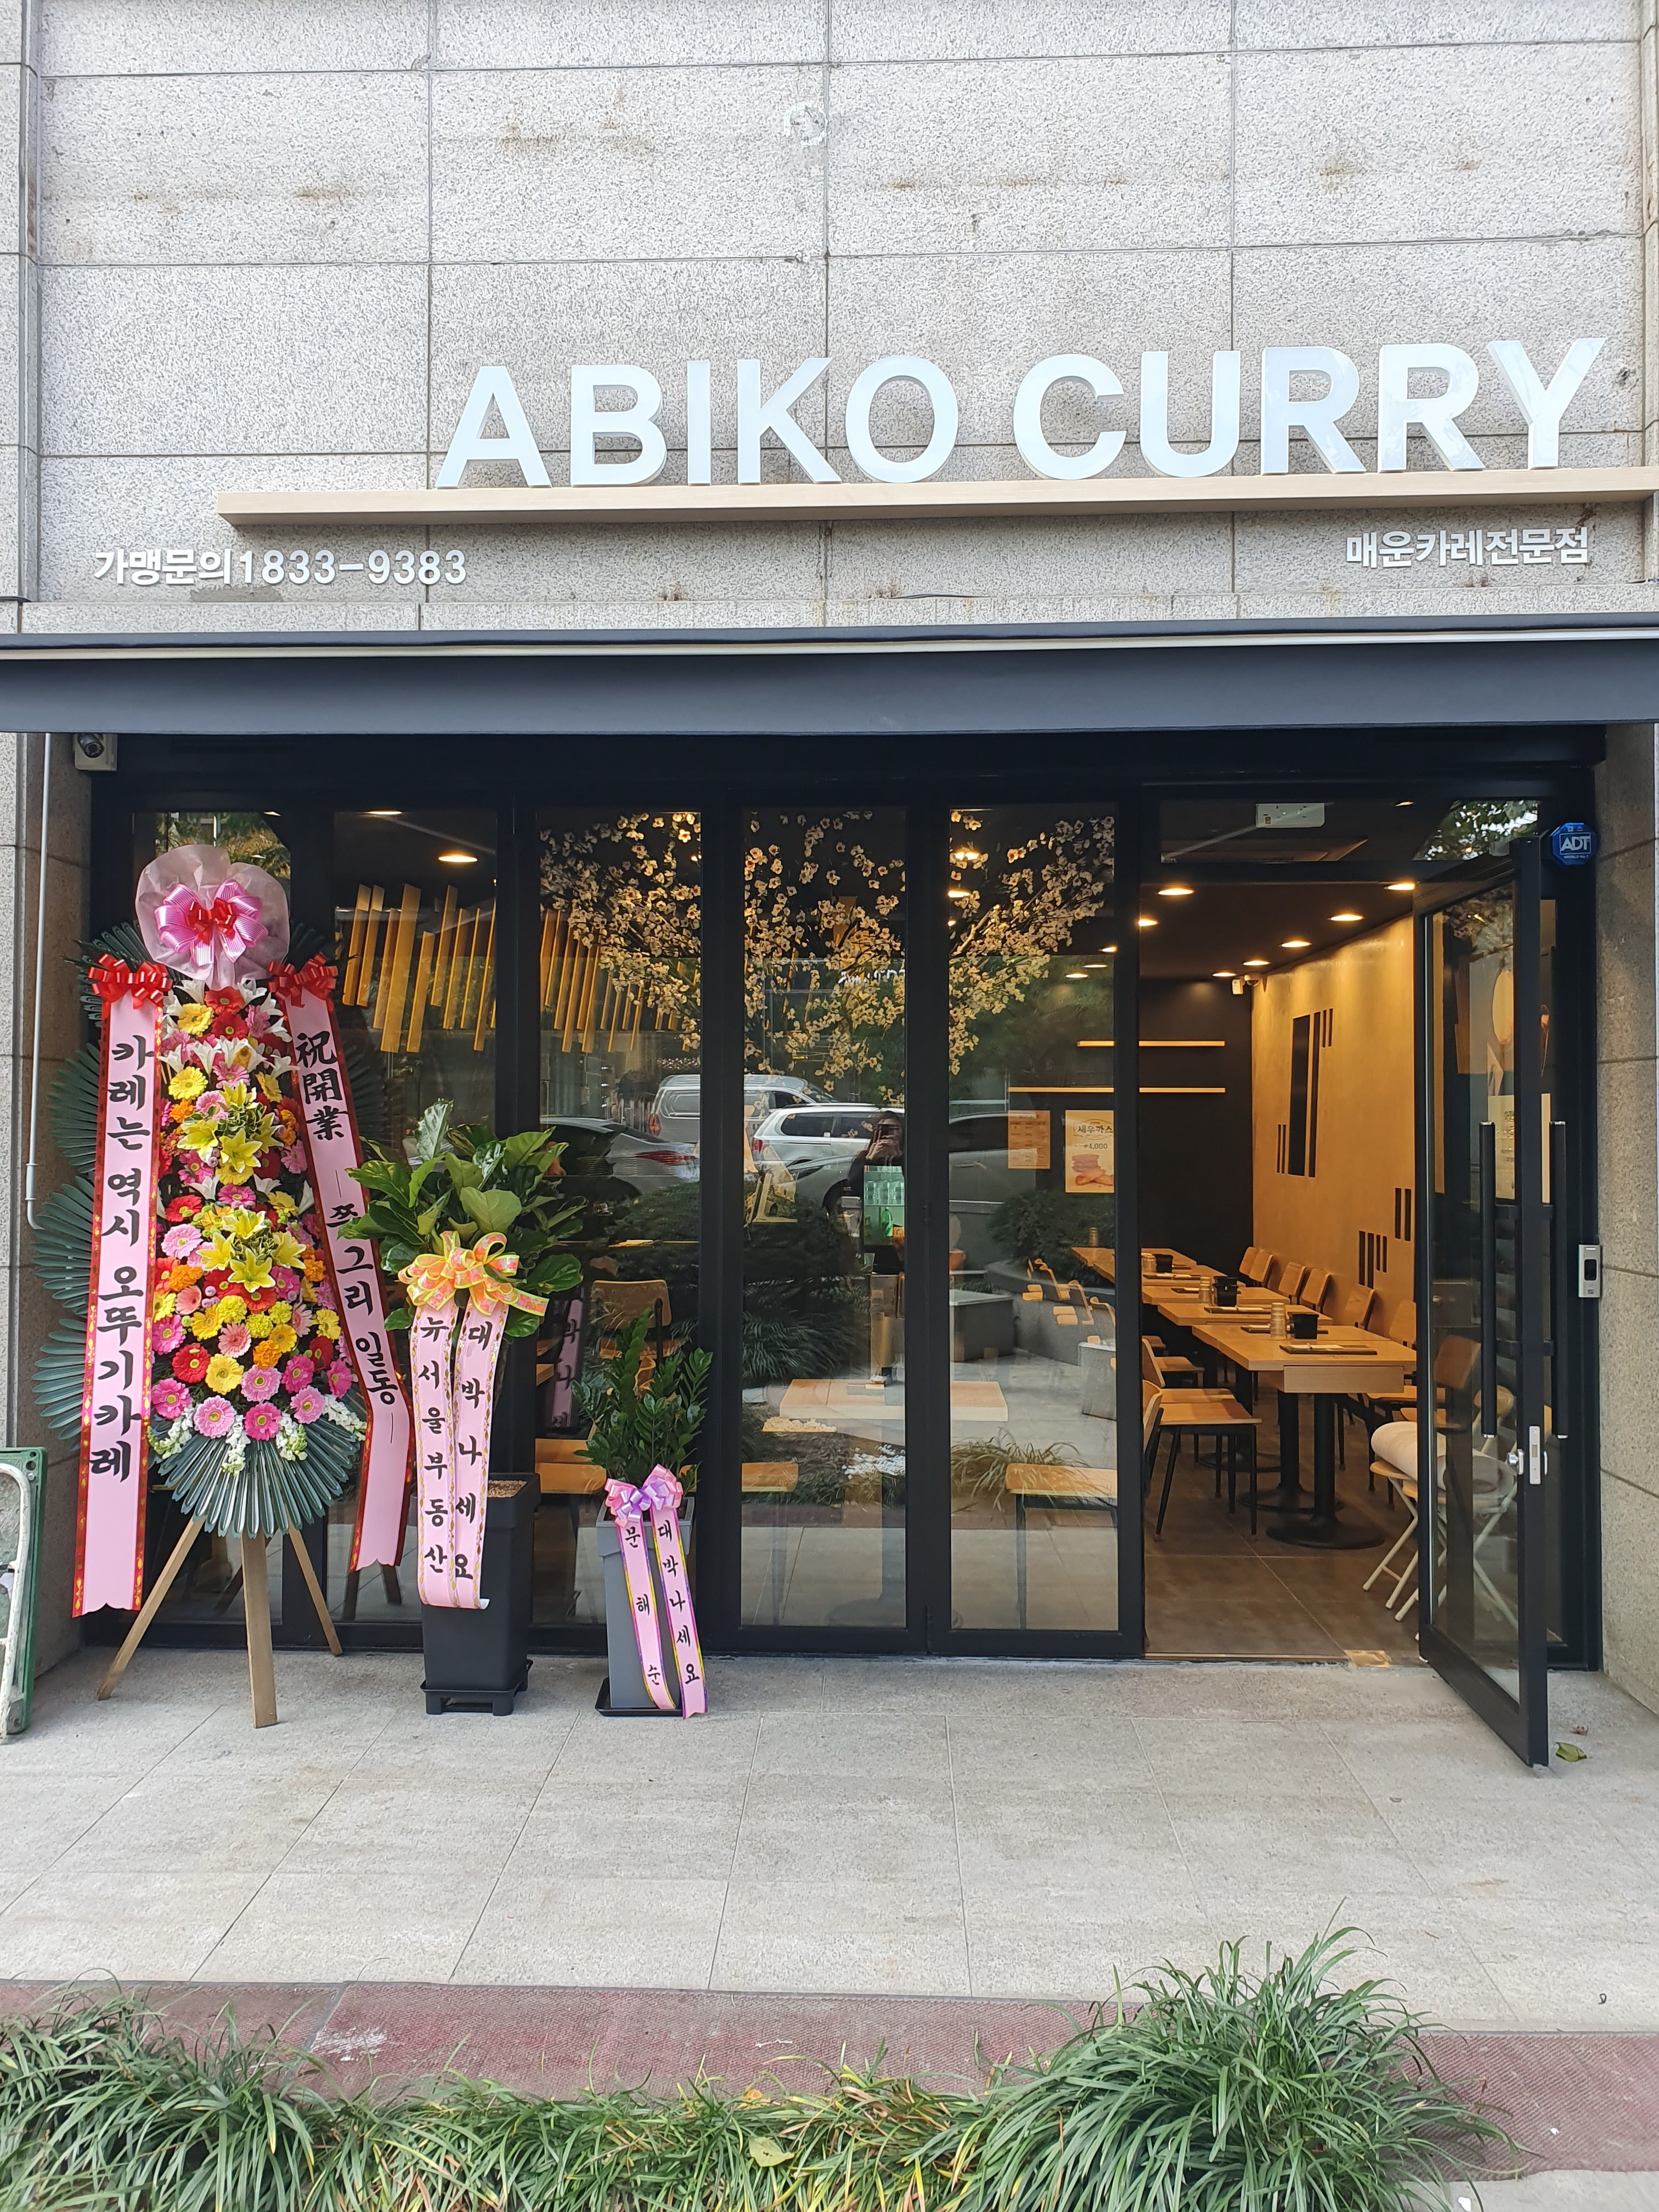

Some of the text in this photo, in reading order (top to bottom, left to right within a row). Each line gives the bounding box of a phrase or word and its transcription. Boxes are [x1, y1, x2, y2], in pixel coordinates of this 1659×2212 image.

[436, 337, 1608, 488] ABIKO CURRY
[1346, 527, 1588, 568] 매운카레전문점
[1561, 836, 1591, 851] ADT
[106, 1035, 155, 1150] 카레는
[101, 1167, 142, 1247] 역시
